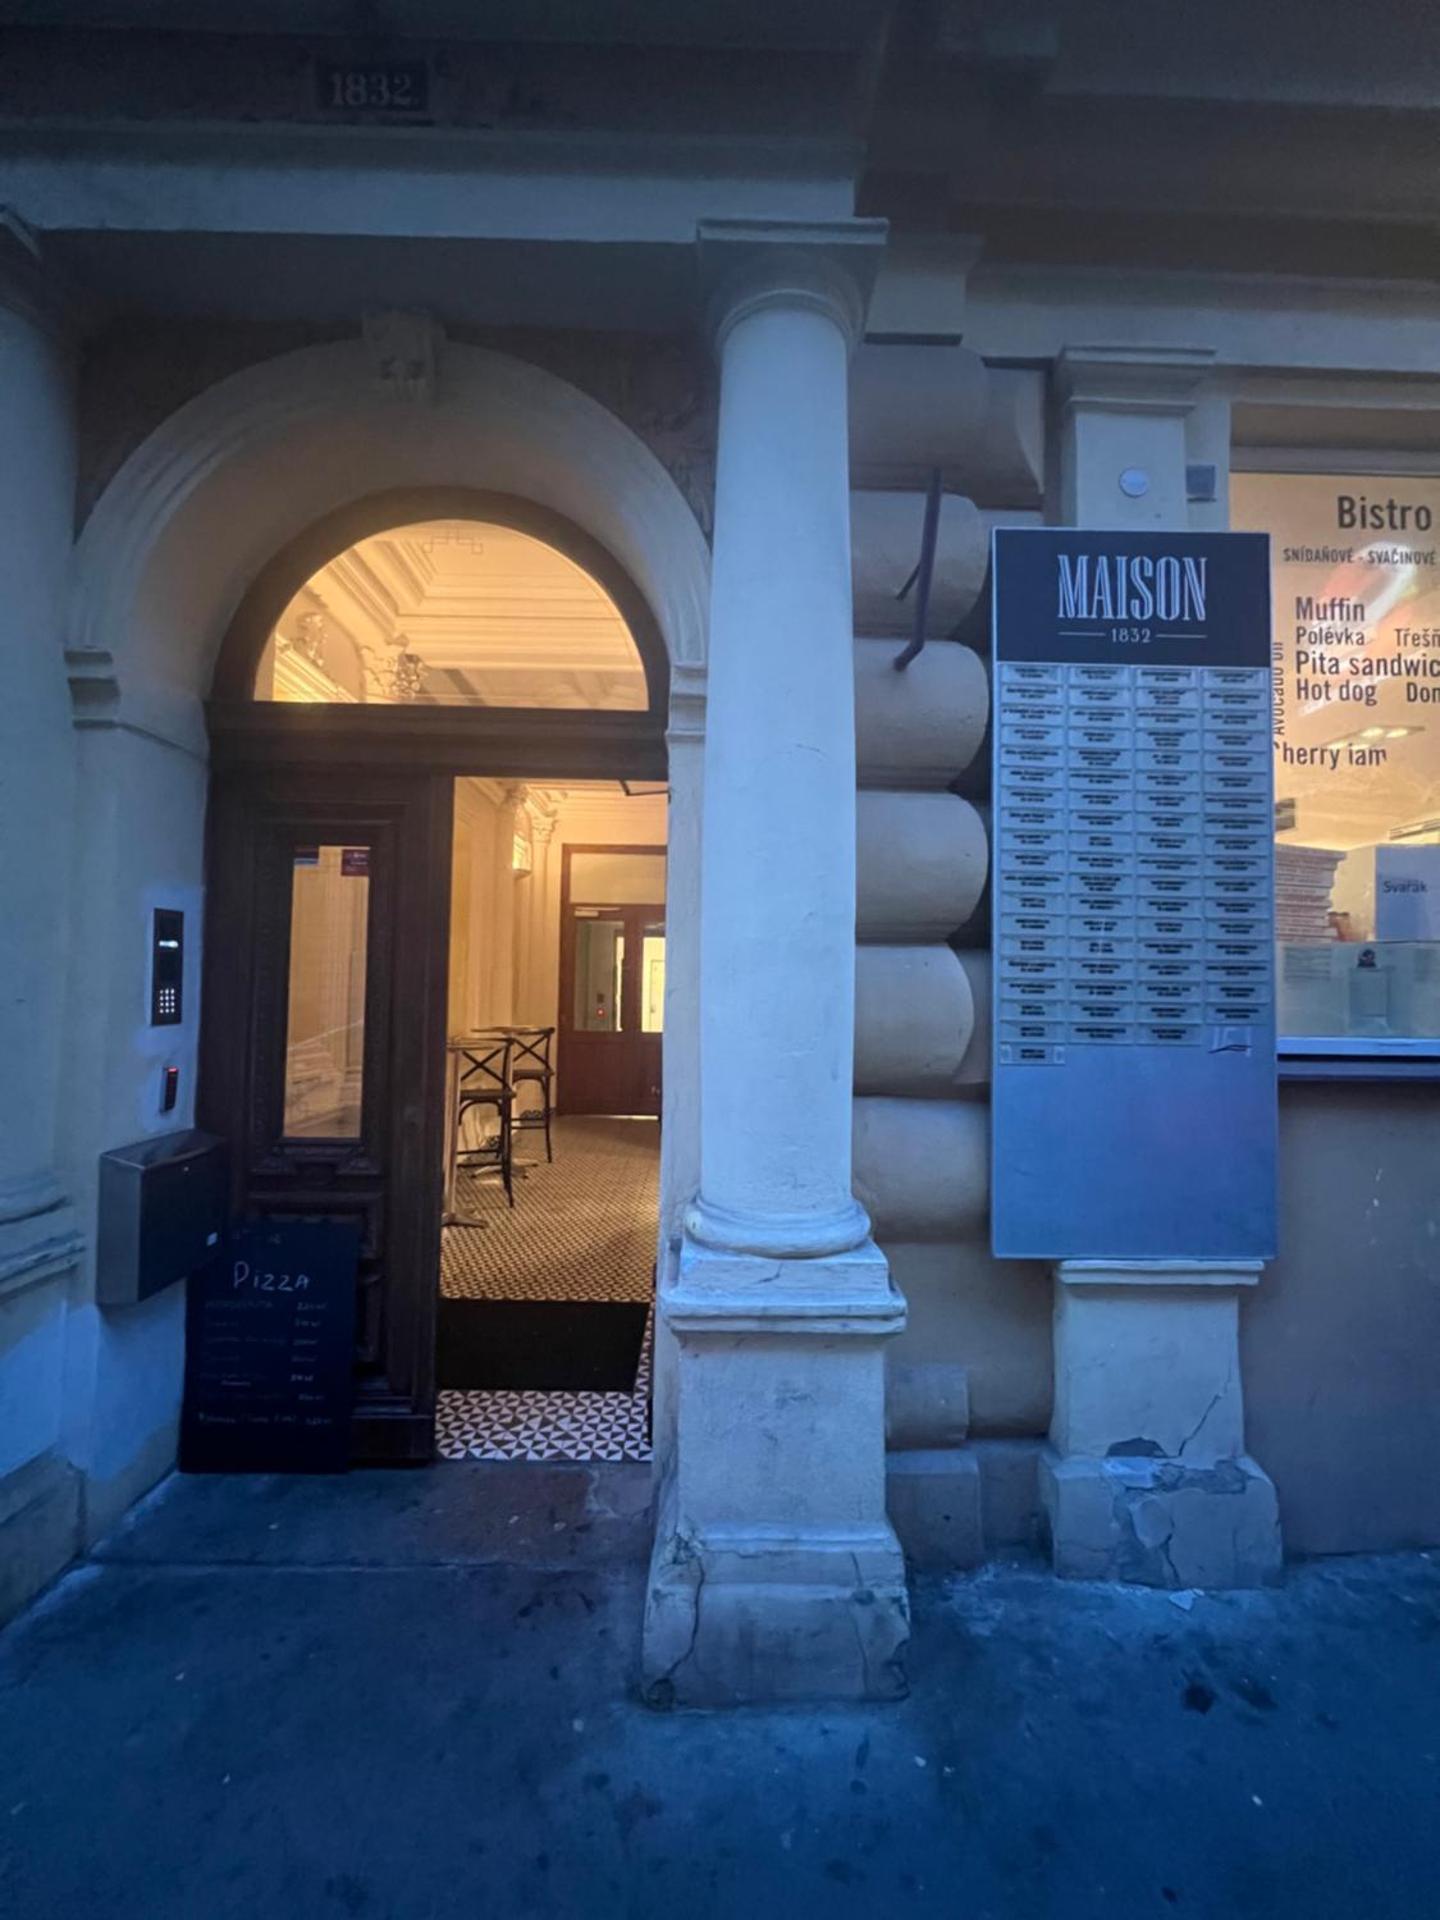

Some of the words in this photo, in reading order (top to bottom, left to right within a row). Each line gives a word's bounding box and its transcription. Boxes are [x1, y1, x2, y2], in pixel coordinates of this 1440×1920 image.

[1337, 496, 1433, 532] Bistro
[1283, 546, 1354, 564] SNÍDAŇOVÉ
[1367, 547, 1437, 566] SVAČINOVÉ
[1057, 554, 1208, 622] MAISON
[1295, 596, 1366, 622] Muffin
[1111, 627, 1152, 644] 1832
[1296, 626, 1366, 646] Polévka
[1296, 650, 1340, 675] Pita
[1296, 678, 1331, 701] Hot
[1339, 679, 1378, 707] dog
[1273, 741, 1340, 770] herry
